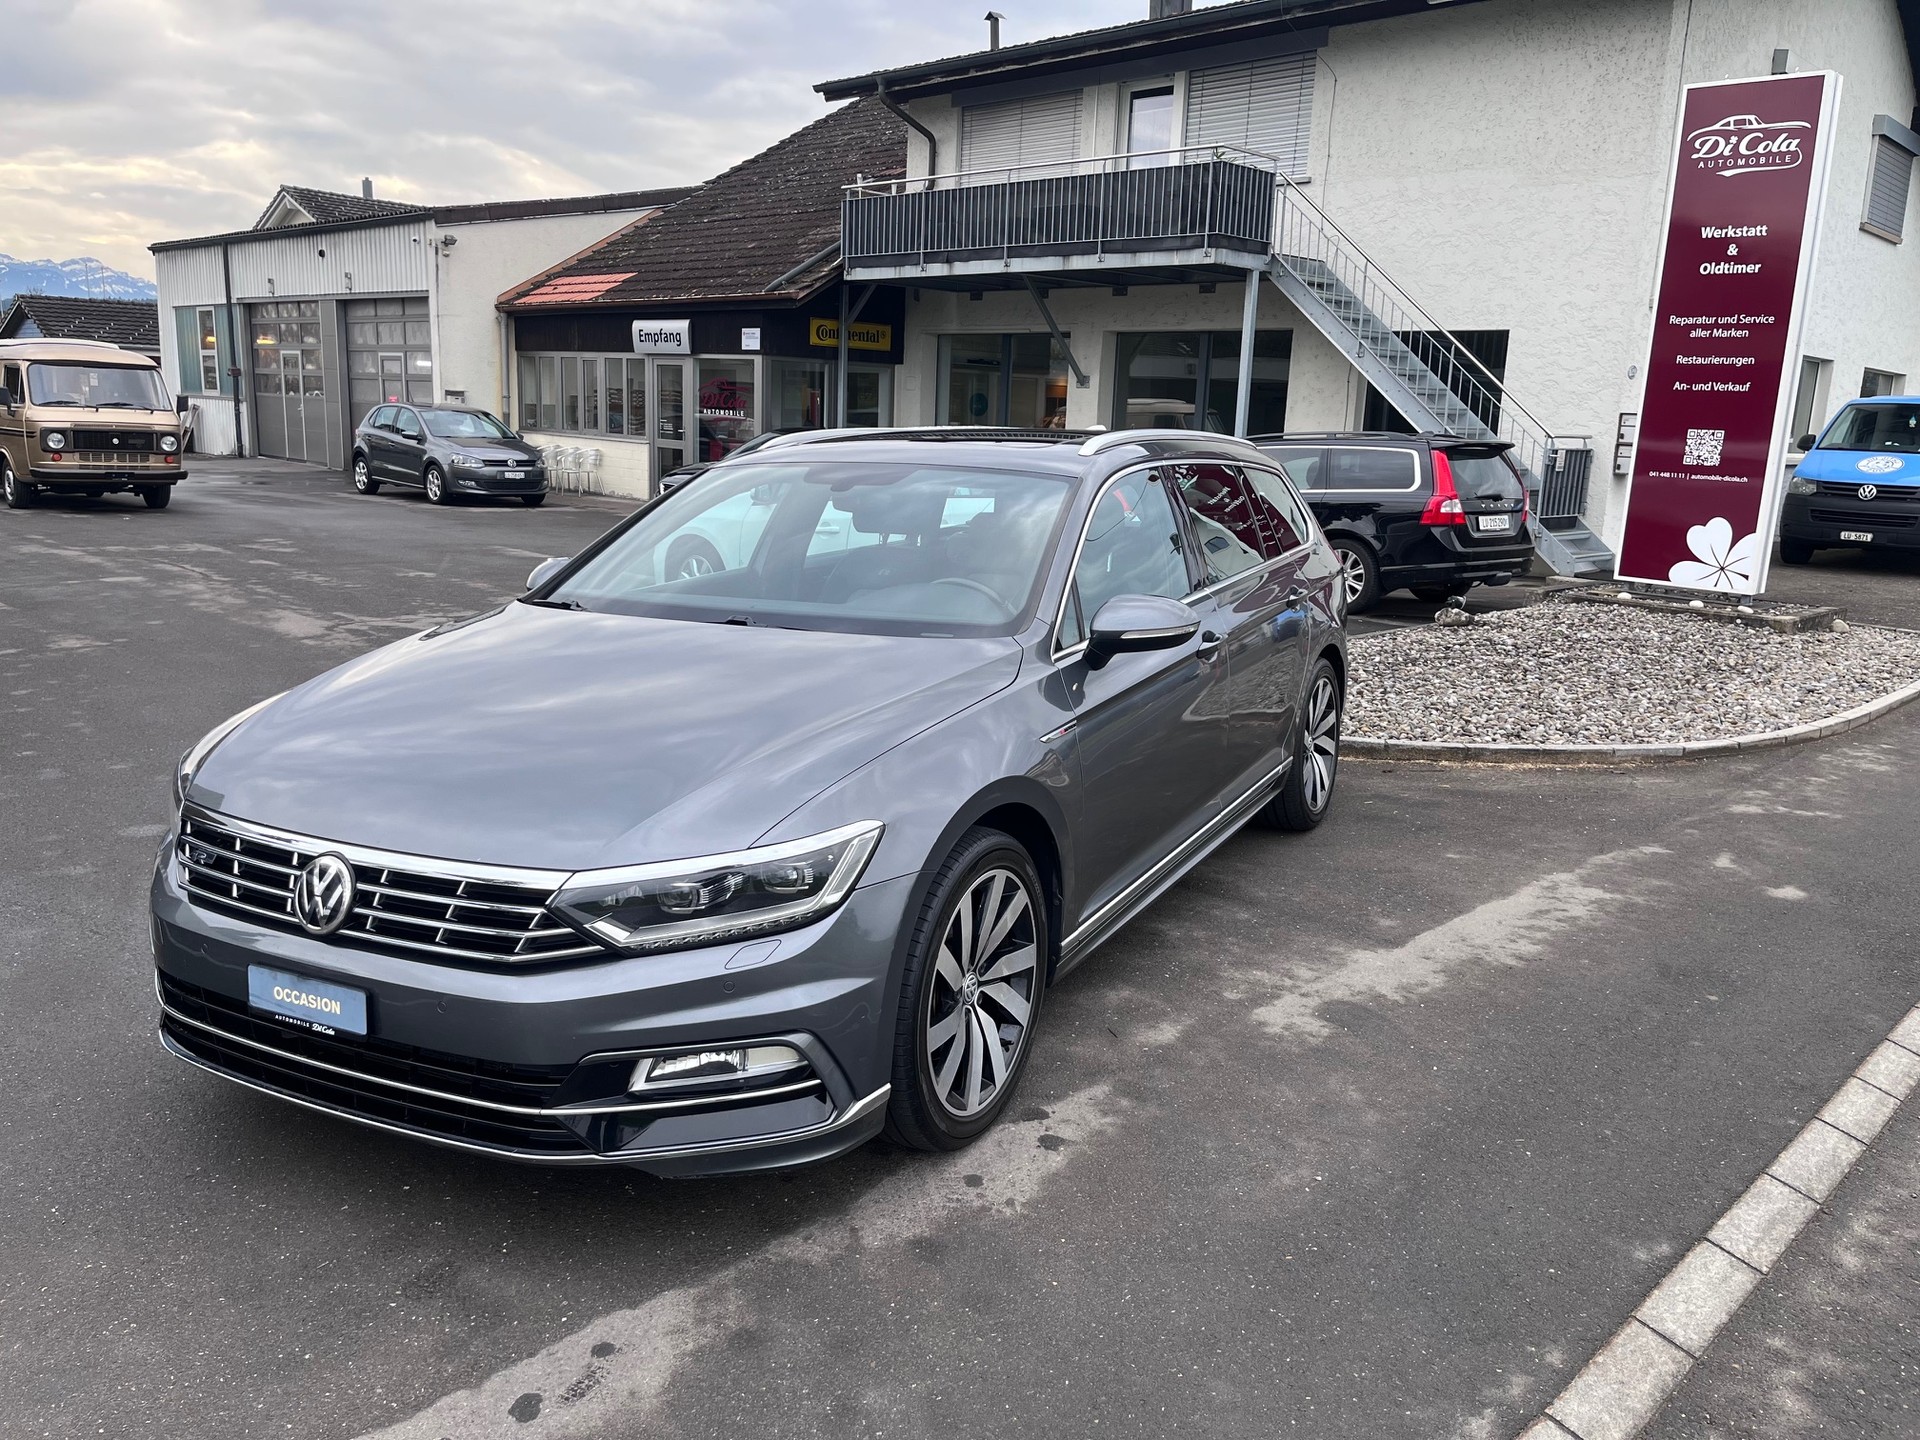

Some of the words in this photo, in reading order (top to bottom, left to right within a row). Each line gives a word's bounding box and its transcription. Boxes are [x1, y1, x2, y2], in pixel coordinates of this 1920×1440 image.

[1698, 155, 1792, 168] AUTOMOBILE
[1701, 225, 1768, 239] Werkstatt
[1727, 243, 1739, 256] &
[1699, 261, 1762, 275] Oldtimer
[1669, 315, 1717, 326] Reparatur
[1717, 314, 1738, 324] und
[1738, 314, 1775, 324] Service
[638, 328, 682, 347] Empfang
[1689, 328, 1712, 338] aller
[1712, 328, 1749, 338] Marken
[1676, 355, 1755, 367] Restaurierungen
[1673, 381, 1690, 391] An-
[1692, 382, 1712, 391] und
[1712, 382, 1751, 392] Verkauf
[703, 408, 745, 417] AUTOMOBILE
[1691, 474, 1748, 483] automobile-dicola.ch
[1843, 531, 1852, 539] LU
[273, 986, 341, 1015] OCCASION
[274, 1013, 311, 1028] AUTOMOBILE
